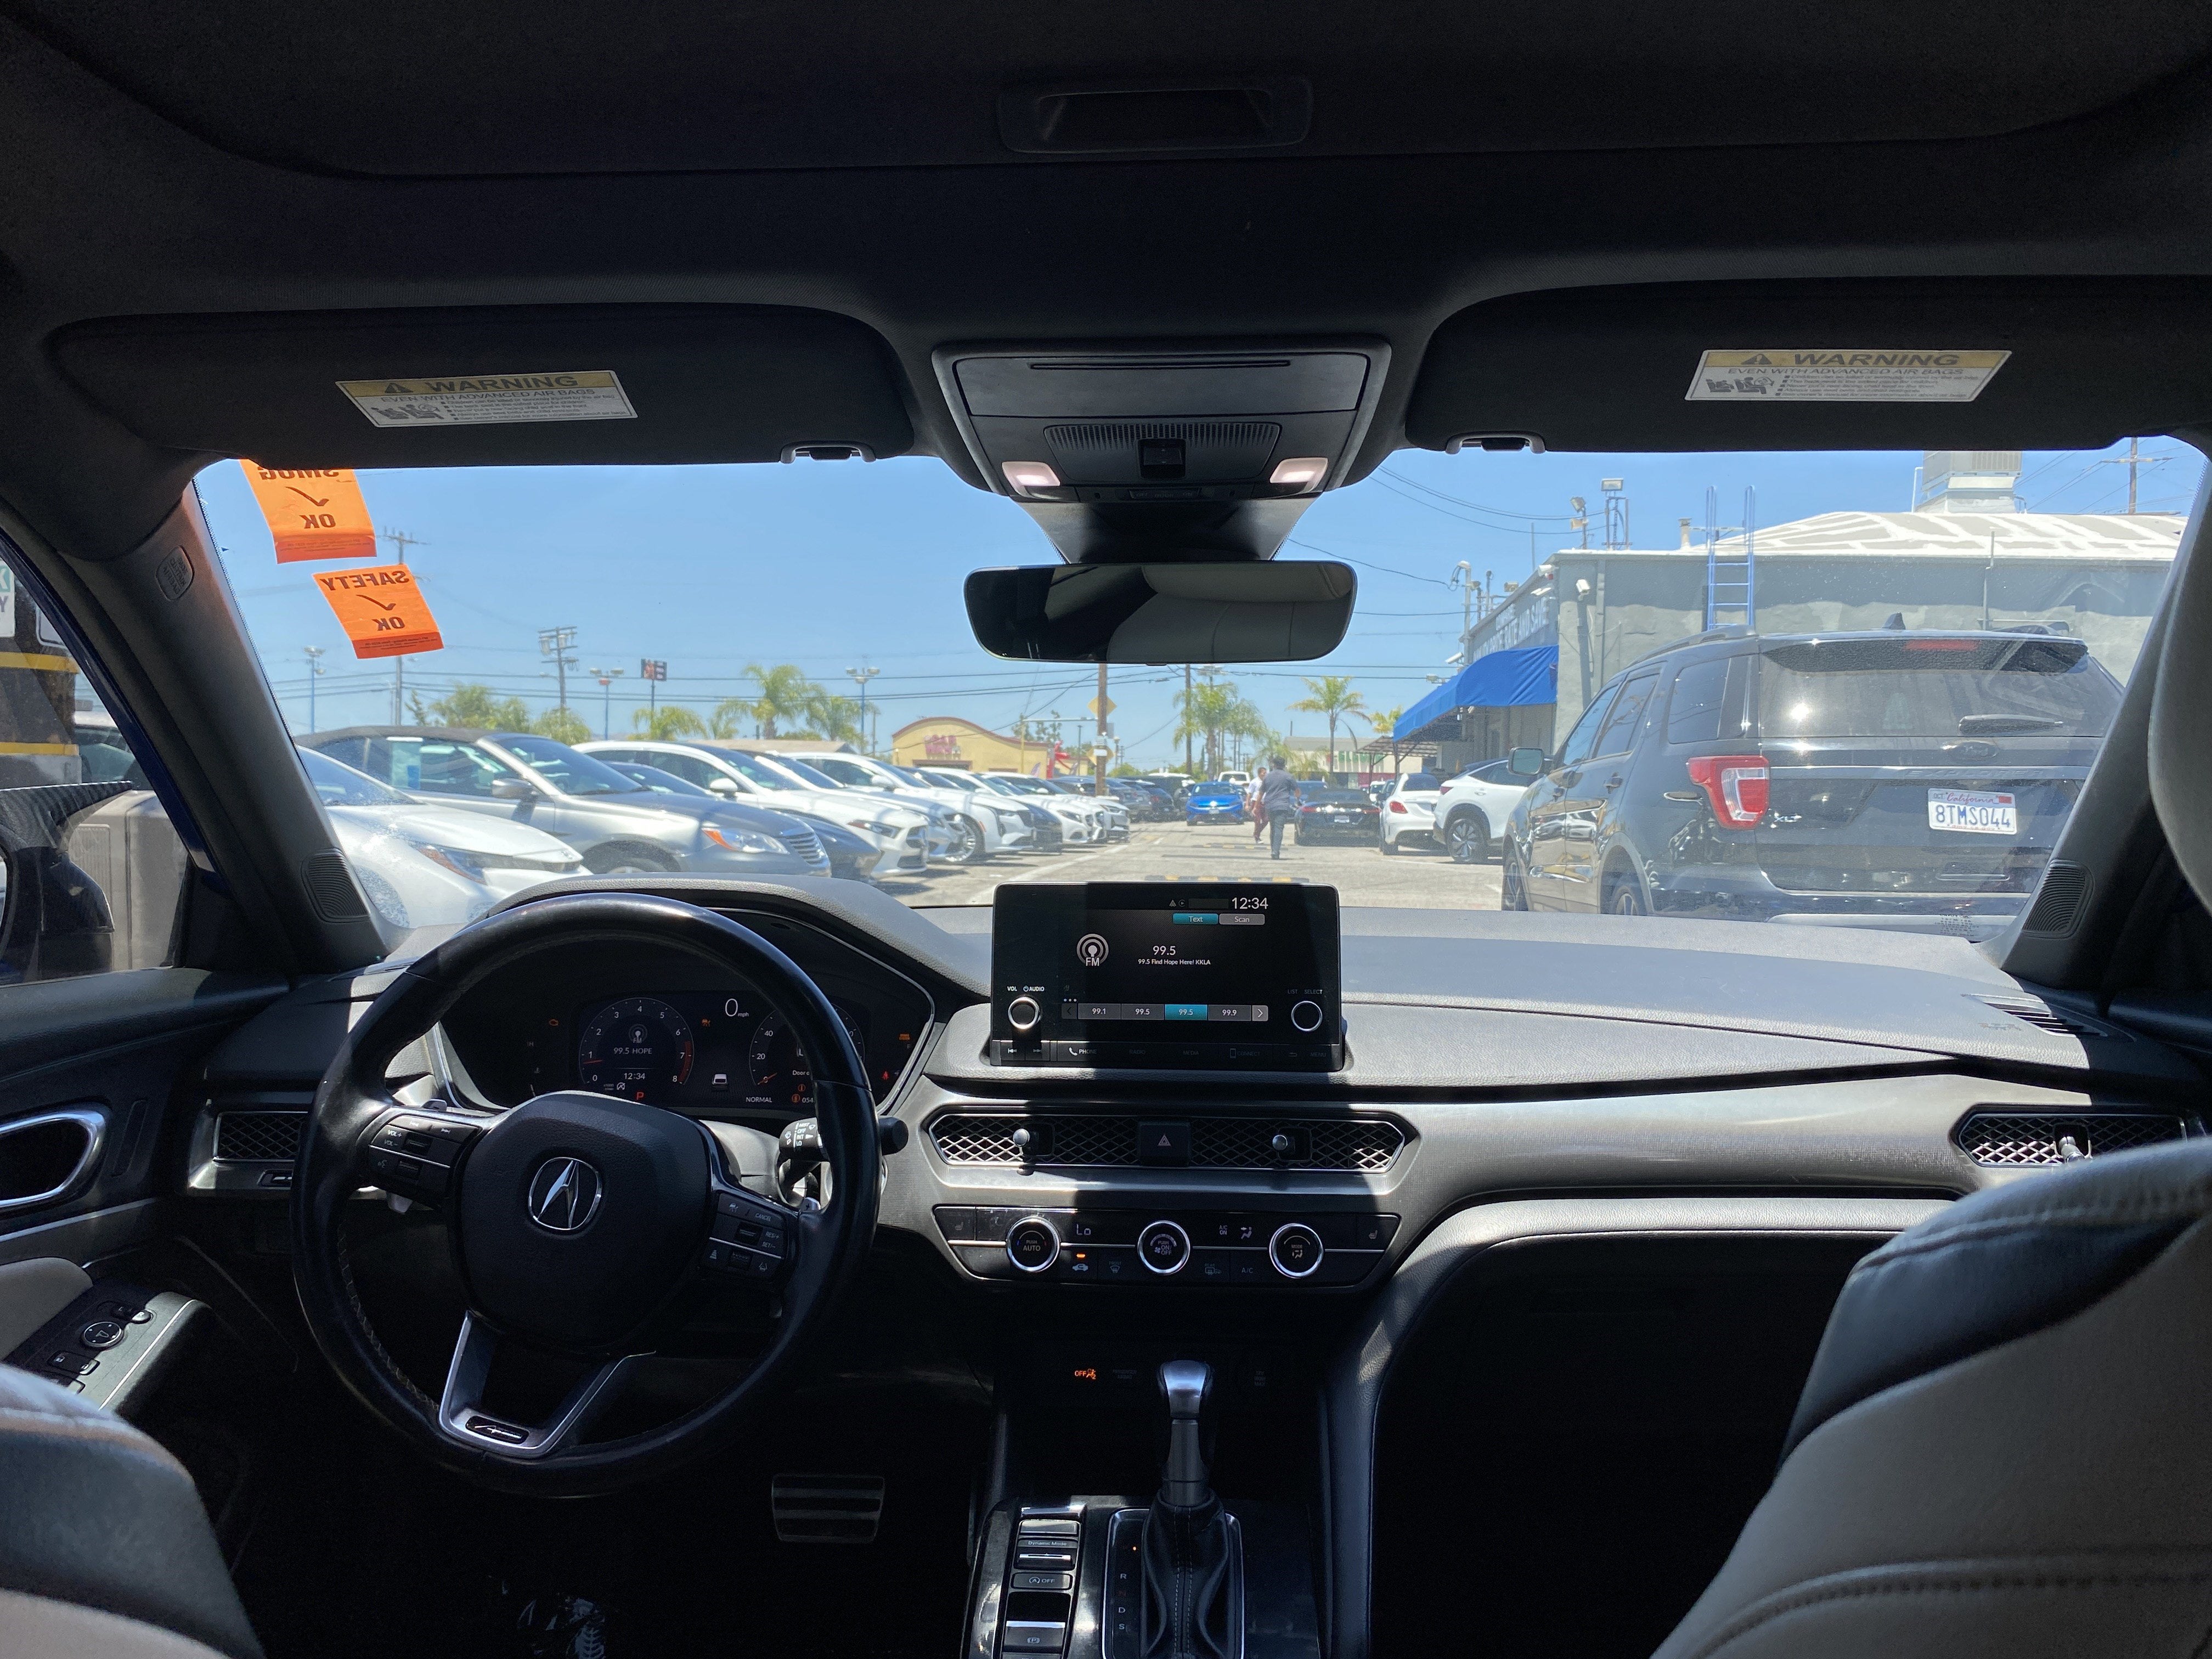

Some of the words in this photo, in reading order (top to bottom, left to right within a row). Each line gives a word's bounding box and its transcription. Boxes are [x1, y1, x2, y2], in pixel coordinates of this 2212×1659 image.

[1793, 353, 1960, 366] WARNING
[425, 376, 578, 393] WARNING
[459, 391, 530, 400] ADVANCED
[1947, 792, 1994, 805] California
[1936, 804, 2011, 828] 8TMS044
[1231, 898, 1269, 910] 12:34
[1153, 945, 1176, 956] 99.5
[1085, 957, 1100, 967] FM
[725, 998, 738, 1017] 0
[636, 1092, 644, 1100] P
[755, 1213, 771, 1222] CANCEL
